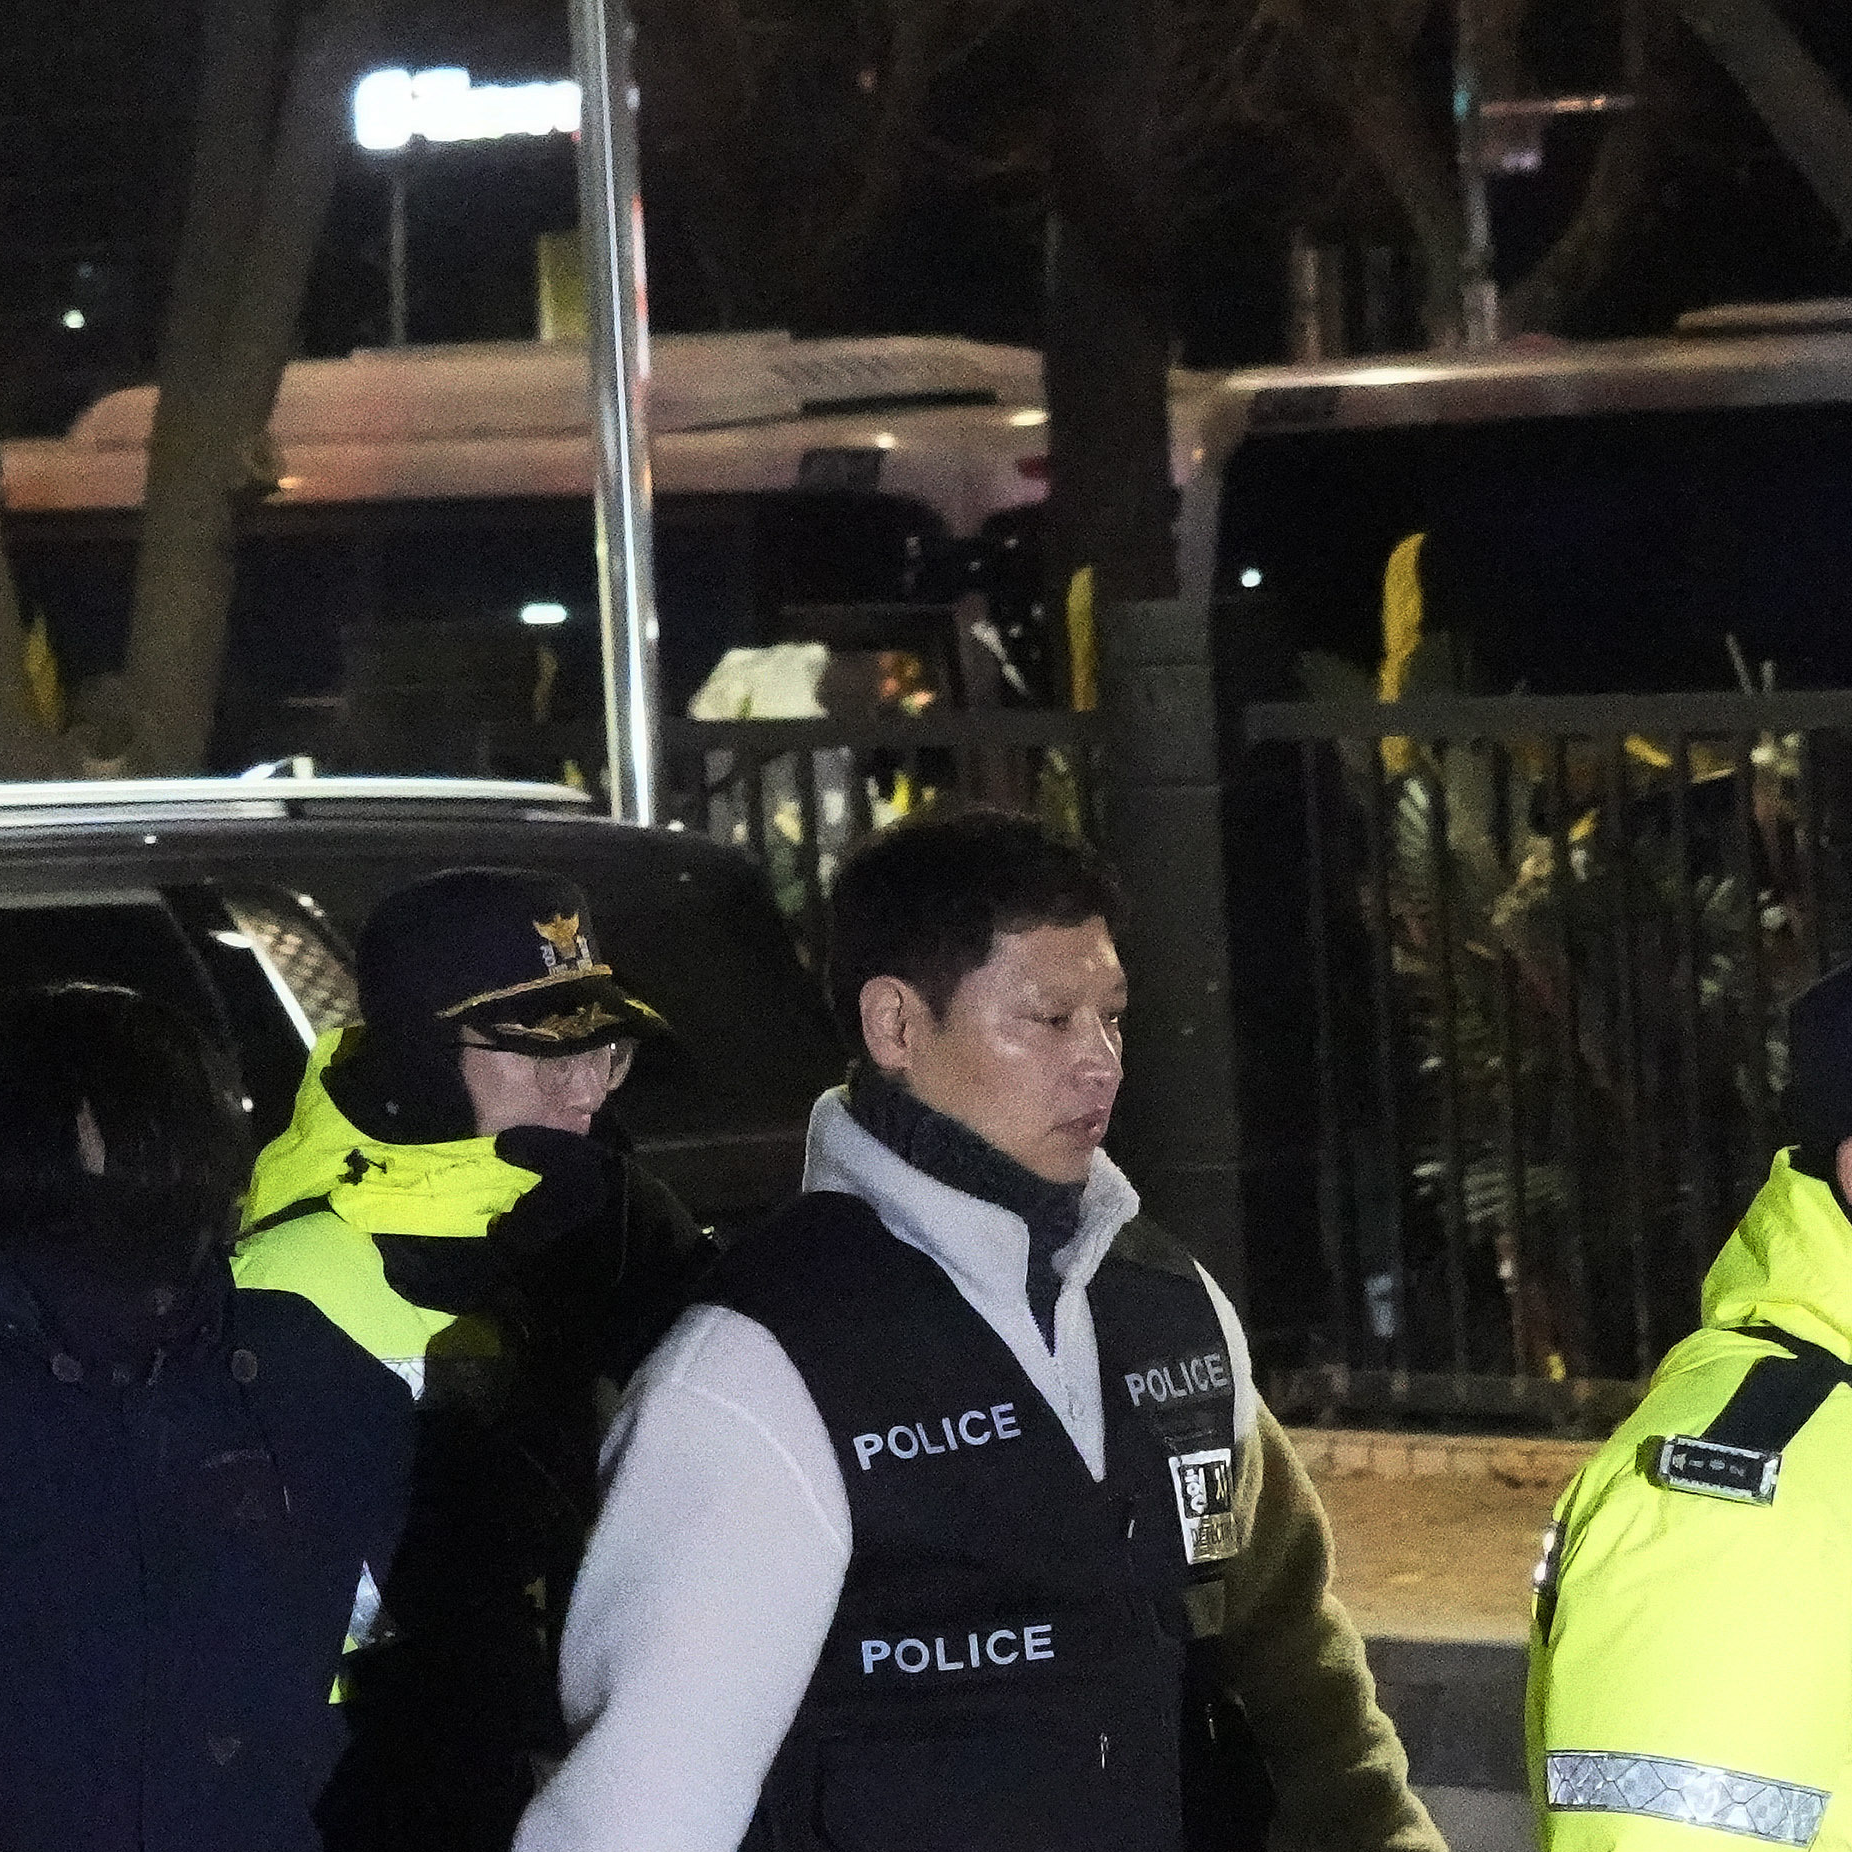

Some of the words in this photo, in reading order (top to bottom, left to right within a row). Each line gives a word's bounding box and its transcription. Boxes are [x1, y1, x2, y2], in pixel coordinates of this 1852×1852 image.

[1125, 1354, 1228, 1406] POLICE
[853, 1402, 1022, 1471] POLICE
[861, 1624, 1055, 1674] POLICE
